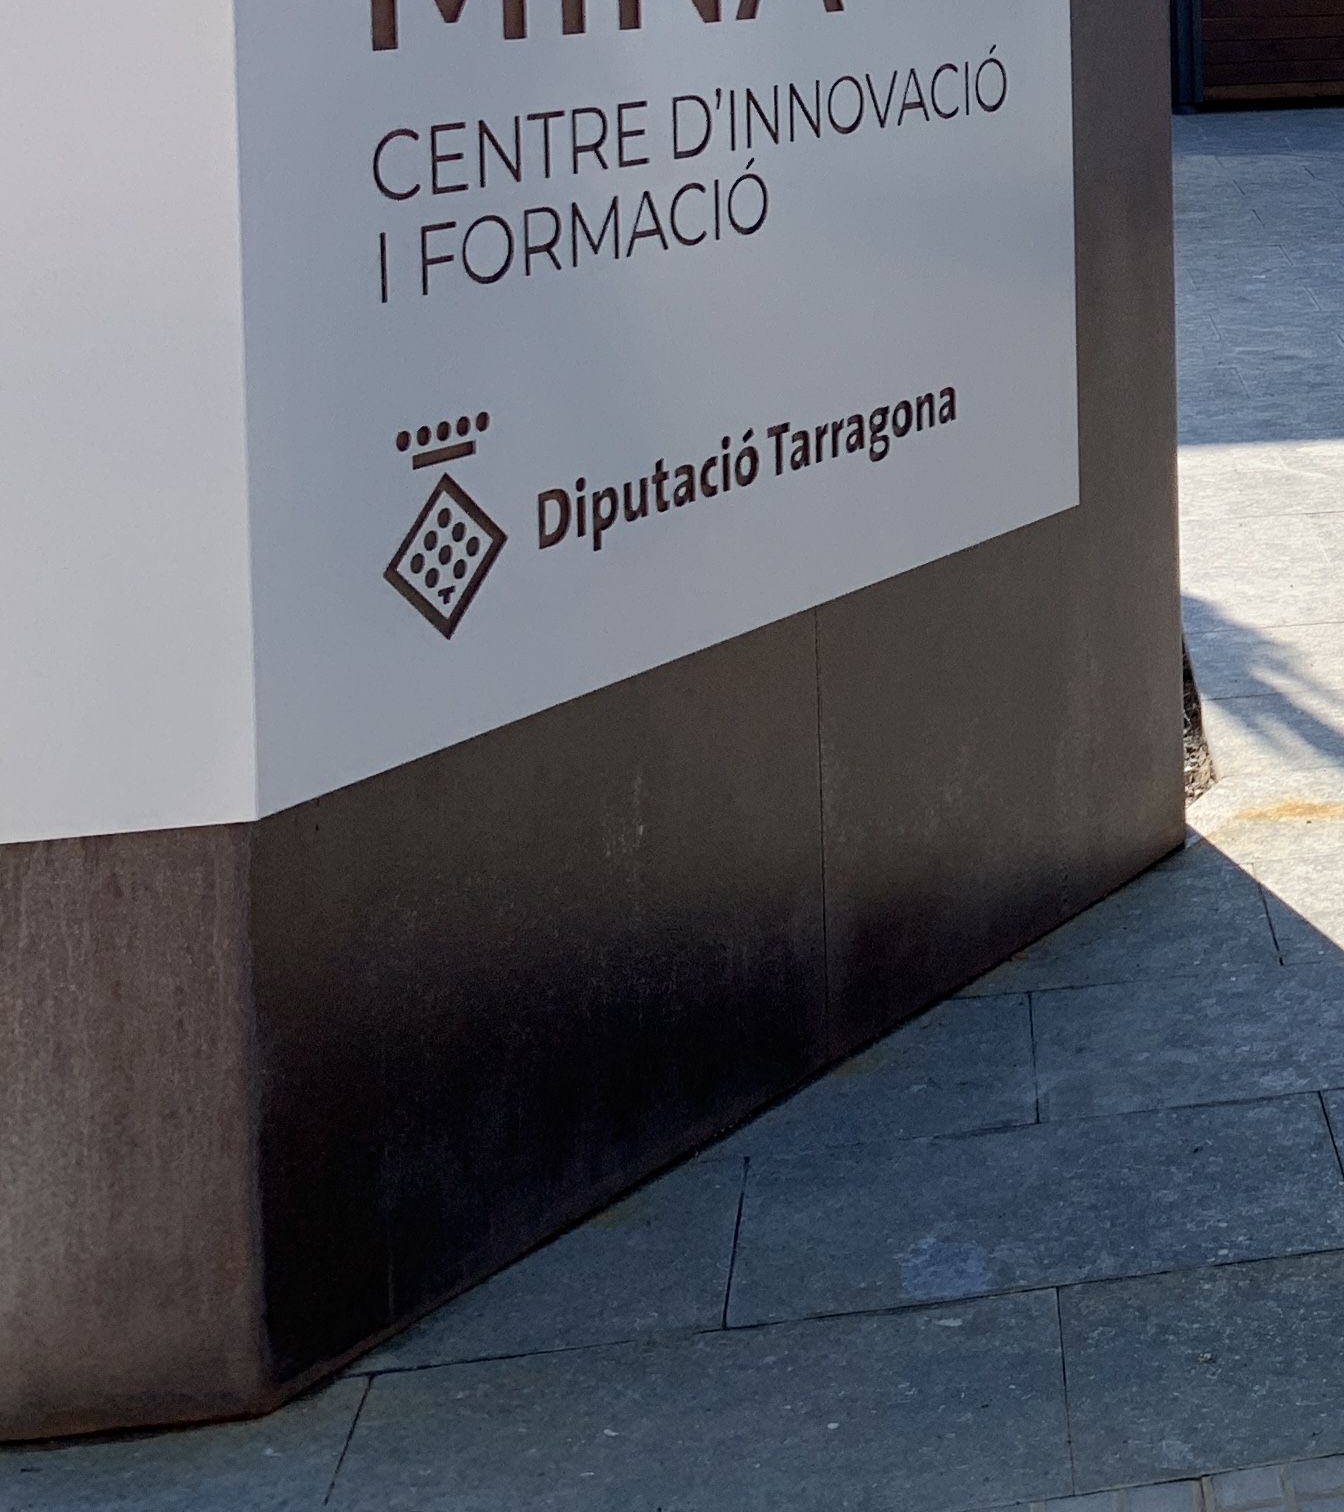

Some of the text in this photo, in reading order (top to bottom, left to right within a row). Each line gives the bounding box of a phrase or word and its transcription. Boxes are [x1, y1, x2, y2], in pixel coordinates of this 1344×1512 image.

[372, 44, 1008, 202] CENTRE D'INNOVACIÓ
[377, 160, 769, 304] I FORMACIÓ
[536, 385, 958, 553] Diputació Tarragona
